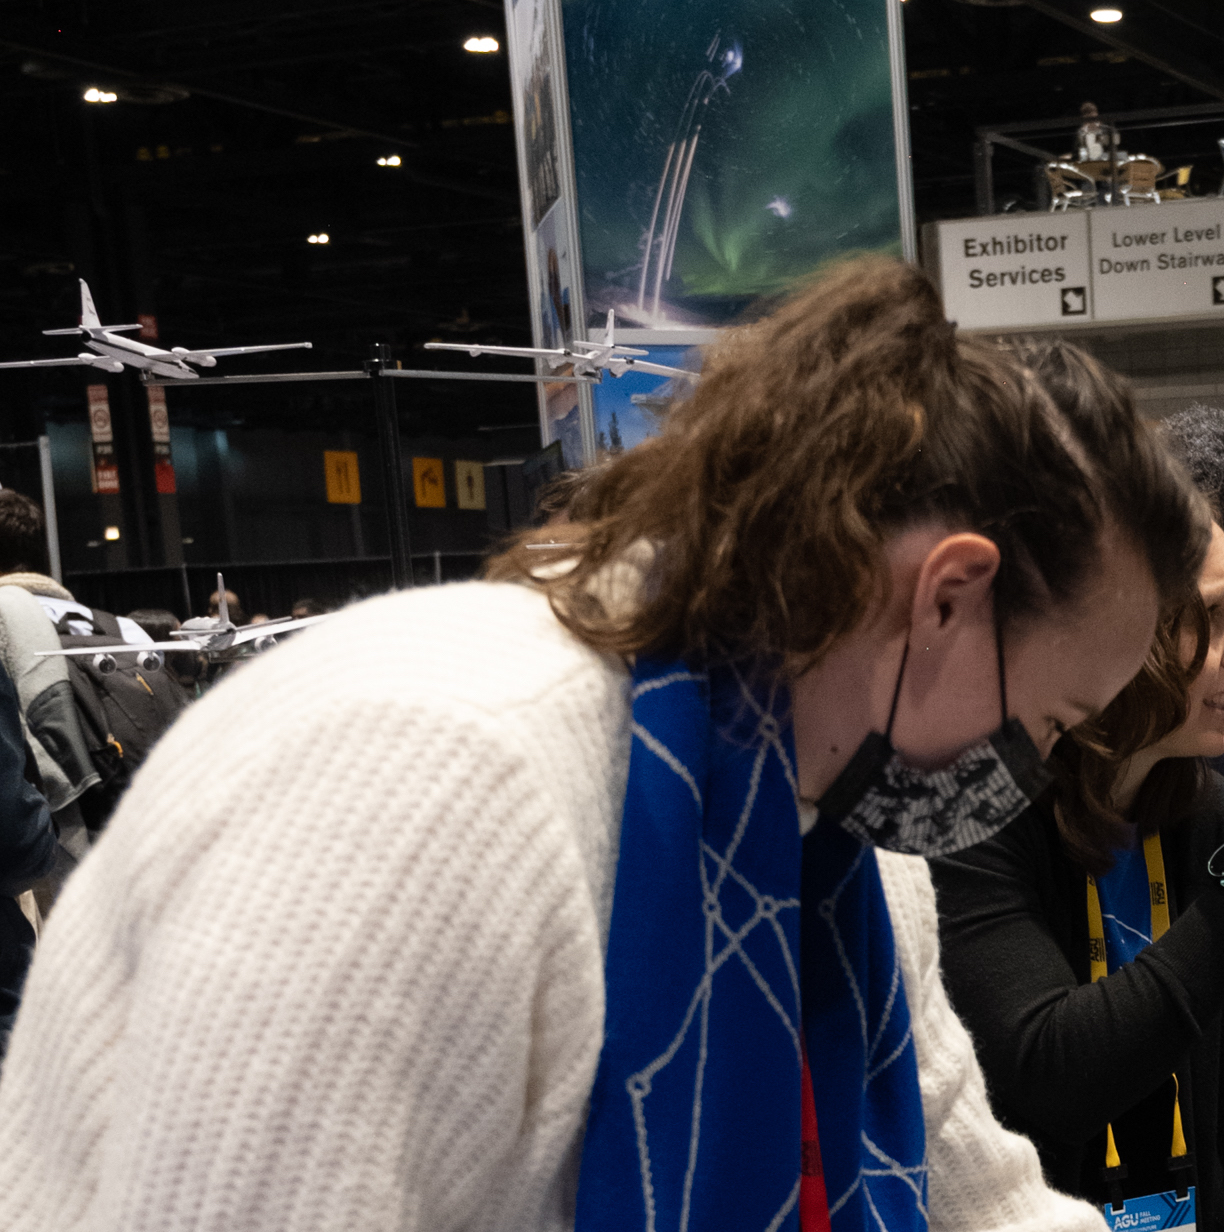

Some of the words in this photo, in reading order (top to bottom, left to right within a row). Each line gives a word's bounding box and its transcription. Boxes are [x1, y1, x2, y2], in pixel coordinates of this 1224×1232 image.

[963, 233, 1068, 258] Exhibitor
[1112, 230, 1168, 249] Lower
[1173, 224, 1222, 244] Level
[968, 264, 1066, 289] Services
[1099, 256, 1152, 275] Down
[1155, 881, 1165, 905] AGU
[1090, 938, 1100, 962] AGU
[1114, 1212, 1139, 1231] AGU
[1140, 1214, 1161, 1225] MEETING
